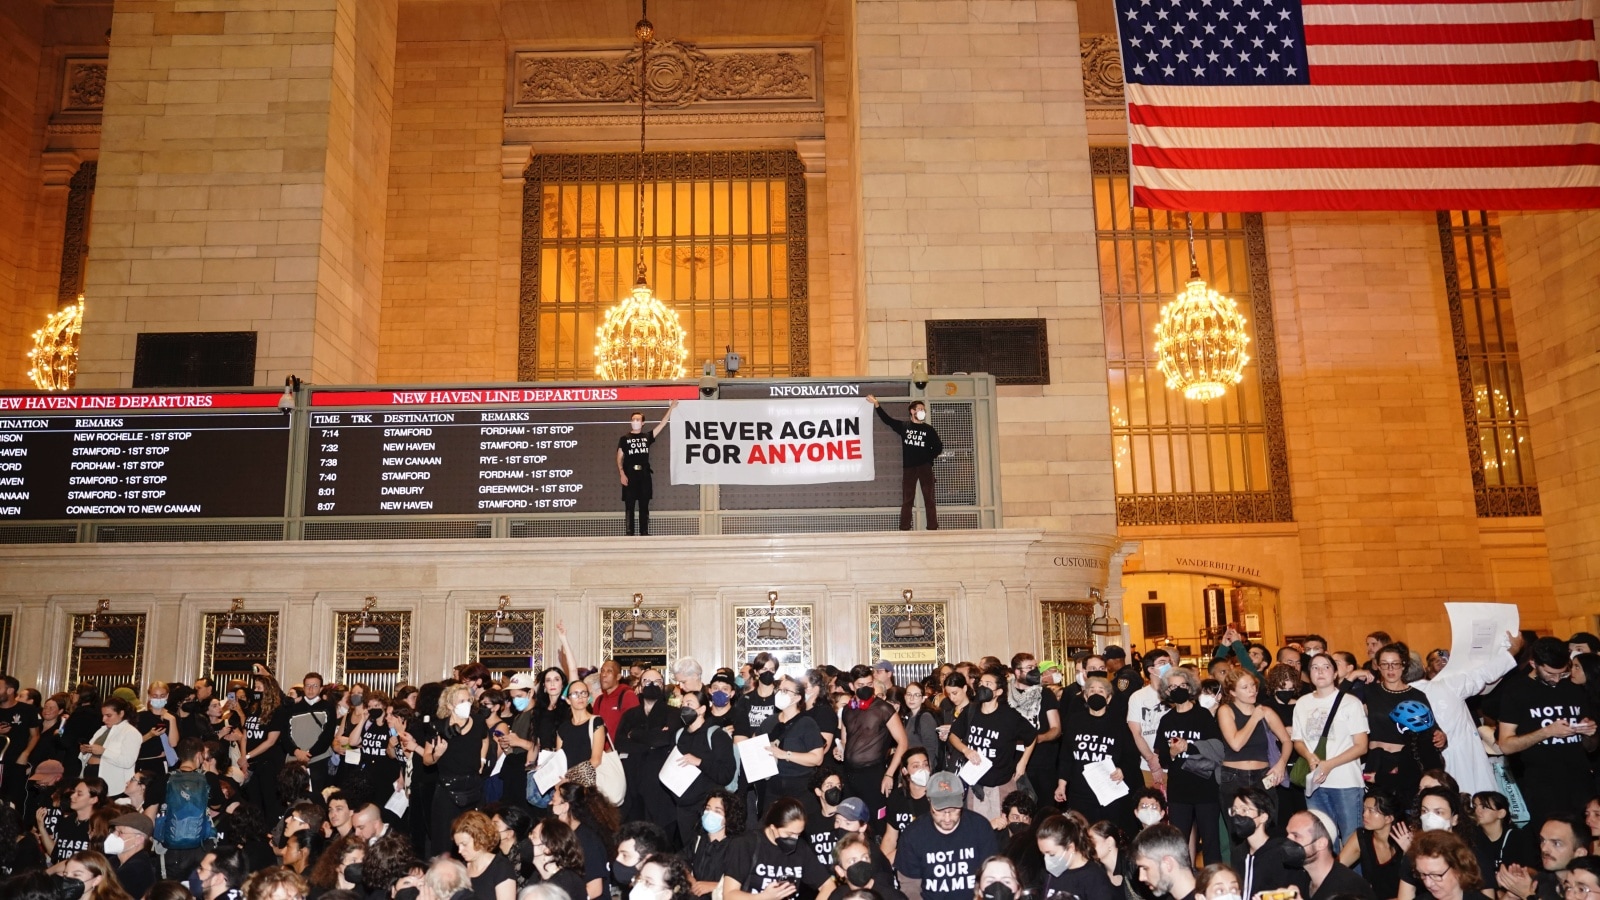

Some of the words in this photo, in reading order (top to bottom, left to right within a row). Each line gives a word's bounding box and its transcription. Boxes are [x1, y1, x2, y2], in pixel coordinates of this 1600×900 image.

[770, 385, 859, 396] INFORMATION
[393, 393, 427, 404] NEW
[430, 392, 483, 404] HAVEN
[486, 391, 520, 403] LINE
[524, 389, 617, 402] DEPARTURES
[26, 398, 78, 409] HAVEN
[81, 397, 115, 409] LINE
[119, 396, 212, 408] DEPARTURES
[75, 419, 123, 428] REMARKS
[314, 415, 340, 424] TIME
[351, 415, 372, 424] TRK
[384, 414, 454, 423] DESTINATION
[481, 413, 529, 422] REMARKS
[322, 430, 339, 438] 7:14
[384, 428, 432, 437] STAMFORD
[481, 427, 524, 436] FORDHAM
[533, 427, 548, 435] 1ST
[550, 426, 573, 435] STOP
[685, 421, 772, 440] NEVER
[780, 417, 860, 440] AGAIN
[74, 433, 94, 442] NEW
[97, 433, 143, 442] ROCHELLE
[151, 433, 166, 441] 1ST
[168, 432, 191, 441] STOP
[73, 448, 120, 456] STAMFORD
[128, 447, 144, 456] 1ST
[146, 447, 169, 456] STOP
[321, 444, 338, 452] 7:32
[384, 443, 403, 452] NEW
[403, 443, 435, 451] HAVEN
[480, 441, 528, 450] STAMFORD
[536, 441, 552, 449] 1ST
[554, 441, 577, 449] STOP
[685, 443, 741, 464] FOR
[747, 440, 862, 464] ANYONE
[71, 462, 115, 471] FORDHAM
[123, 462, 139, 470] 1ST
[140, 461, 164, 470] STOP
[321, 459, 337, 467] 7:38
[383, 458, 403, 466] NEW
[405, 457, 441, 466] CANAAN
[480, 456, 497, 465] RYE
[506, 456, 521, 465] 1ST
[523, 456, 547, 464] STOP
[69, 477, 118, 485] STAMFORD
[126, 476, 141, 485] 1ST
[143, 476, 167, 485] STOP
[320, 474, 336, 482] 7:40
[382, 472, 430, 481] STAMFORD
[480, 471, 523, 479] FORDHAM
[531, 470, 547, 479] 1ST
[549, 470, 573, 479] STOP
[68, 491, 116, 500] STAMFORD
[124, 491, 140, 500] 1ST
[142, 491, 165, 499] STOP
[319, 488, 334, 496] 8:01
[381, 487, 424, 496] DANBURY
[479, 485, 533, 494] GREENWICH
[541, 485, 557, 493] 1ST
[559, 484, 583, 493] STOP
[66, 506, 125, 515] CONNECTION
[127, 506, 140, 514] TO
[142, 505, 162, 514] NEW
[164, 505, 200, 514] CANAAN
[318, 503, 335, 511] 8:07
[381, 502, 401, 510] NEW
[403, 501, 433, 510] HAVEN
[478, 500, 527, 509] STAMFORD
[535, 500, 551, 508] 1ST
[553, 499, 576, 508] STOP
[1176, 557, 1235, 572] VANDERBILT
[1237, 565, 1261, 577] HALL
[893, 651, 926, 659] TICKETS
[1530, 705, 1564, 718] NOT
[986, 729, 999, 740] IN
[1075, 734, 1098, 742] NOT
[1102, 736, 1115, 745] IN
[1164, 730, 1185, 738] NOT
[1188, 730, 1200, 740] IN
[362, 739, 382, 748] OUR
[1078, 741, 1108, 753] OUR
[810, 832, 830, 843] NOT
[58, 839, 88, 850] CEASE
[926, 850, 954, 864] NOT
[959, 847, 975, 860] IN
[755, 863, 802, 878] CEASE
[933, 861, 969, 878] OUR
[925, 875, 976, 892] NAME
